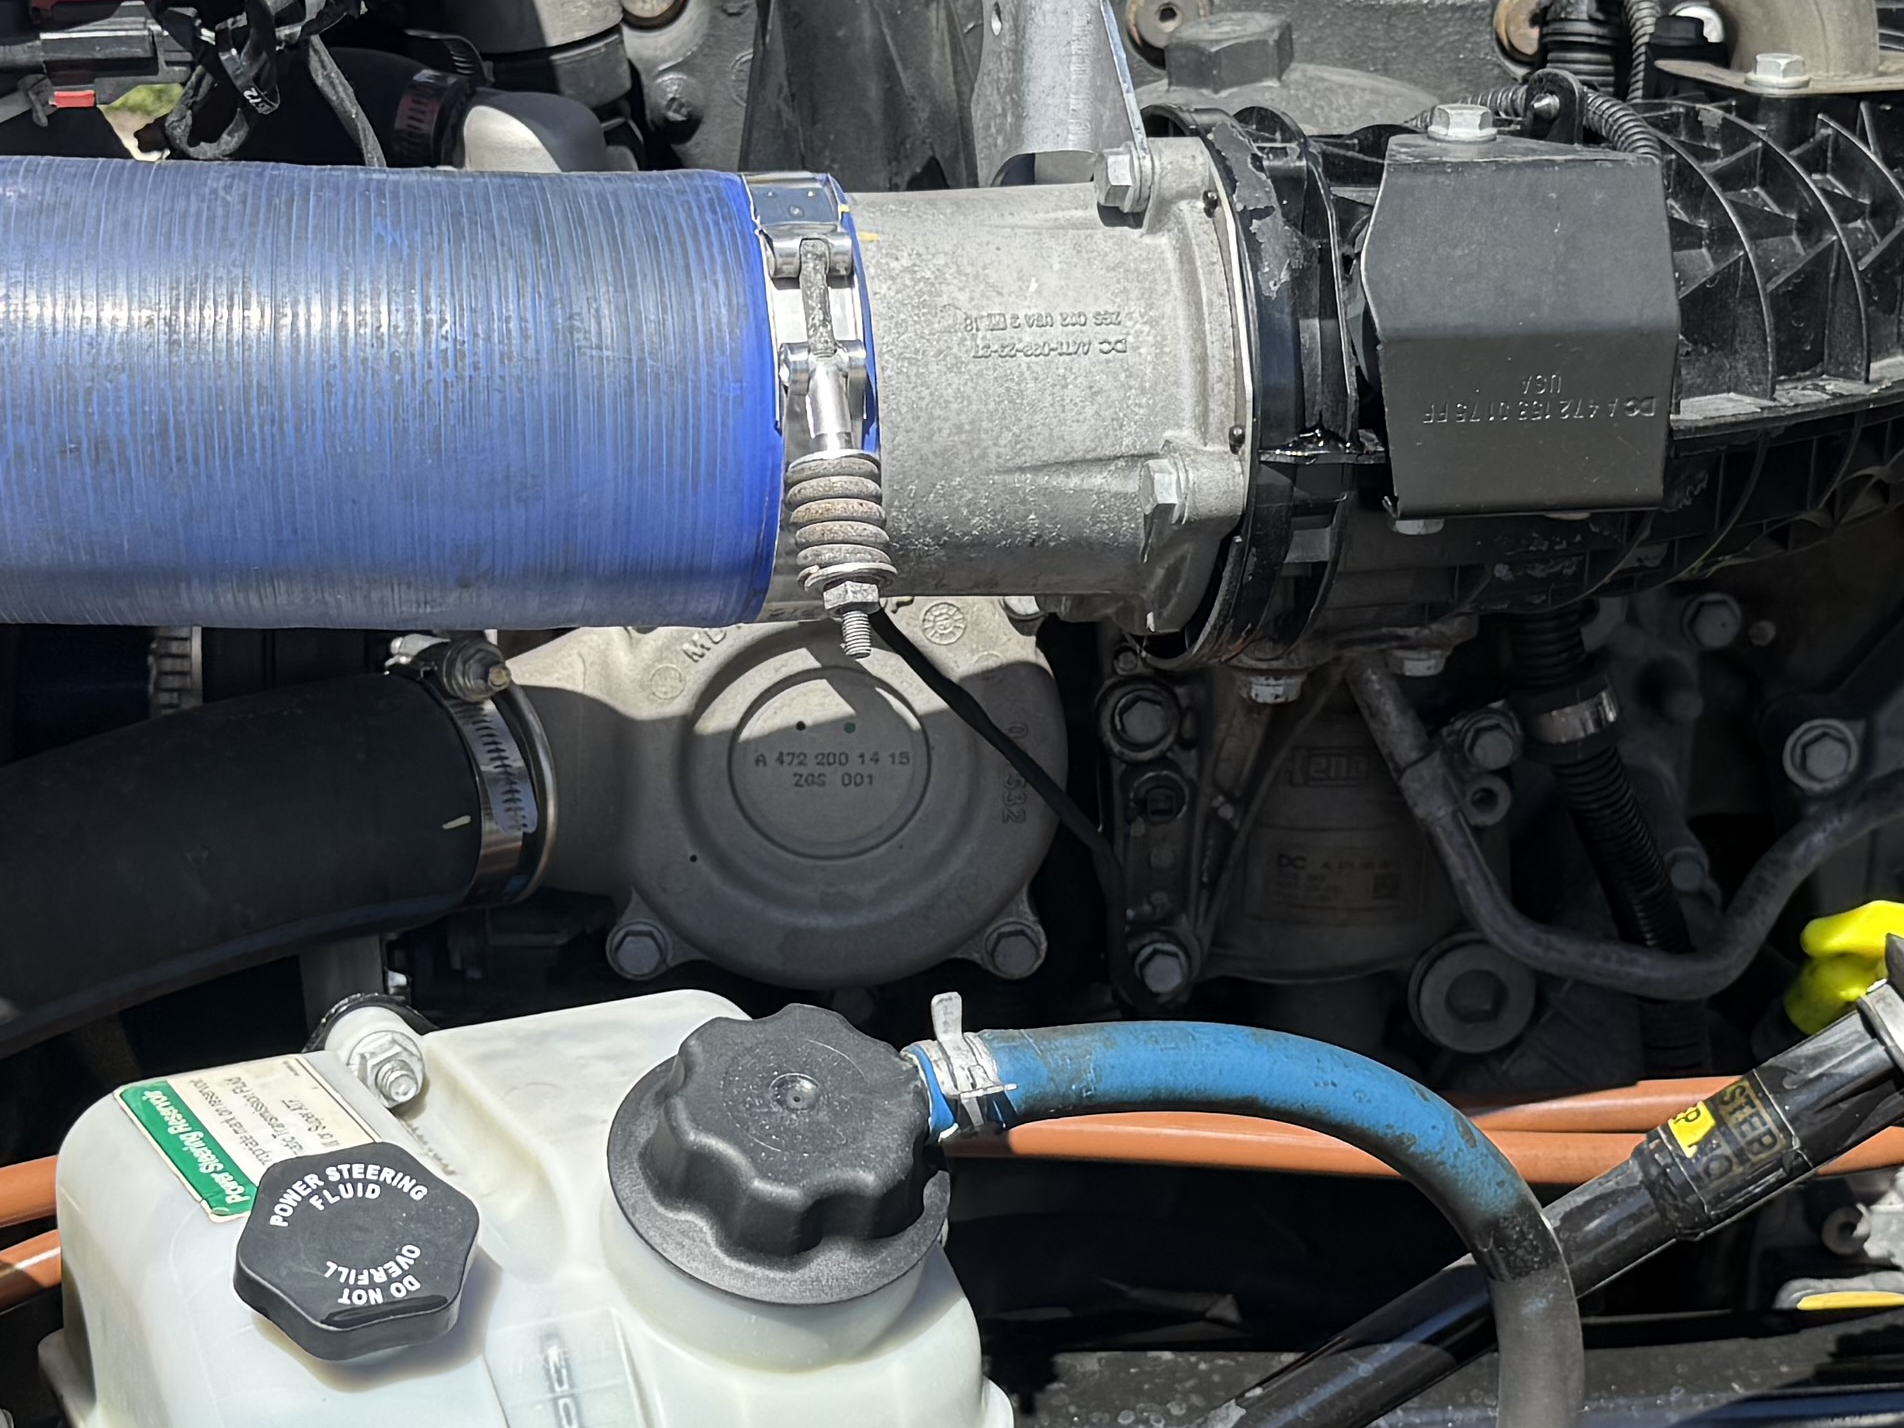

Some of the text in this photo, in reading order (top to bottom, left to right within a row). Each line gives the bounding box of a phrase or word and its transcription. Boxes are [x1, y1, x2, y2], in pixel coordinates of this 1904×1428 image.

[1521, 373, 1562, 394] USA
[1421, 403, 1449, 424] FF
[1558, 398, 1600, 420] 472
[1624, 395, 1658, 418] DC
[775, 752, 809, 769] 472
[859, 752, 880, 768] 14
[223, 1075, 290, 1139] Transmission Fluid
[143, 1089, 251, 1205] Power Steering Reservoir
[269, 1163, 428, 1228] POWER STEERING
[309, 1183, 381, 1212] FLUID
[324, 1243, 421, 1286] OVERFILL
[337, 1277, 421, 1306] DO NOT
